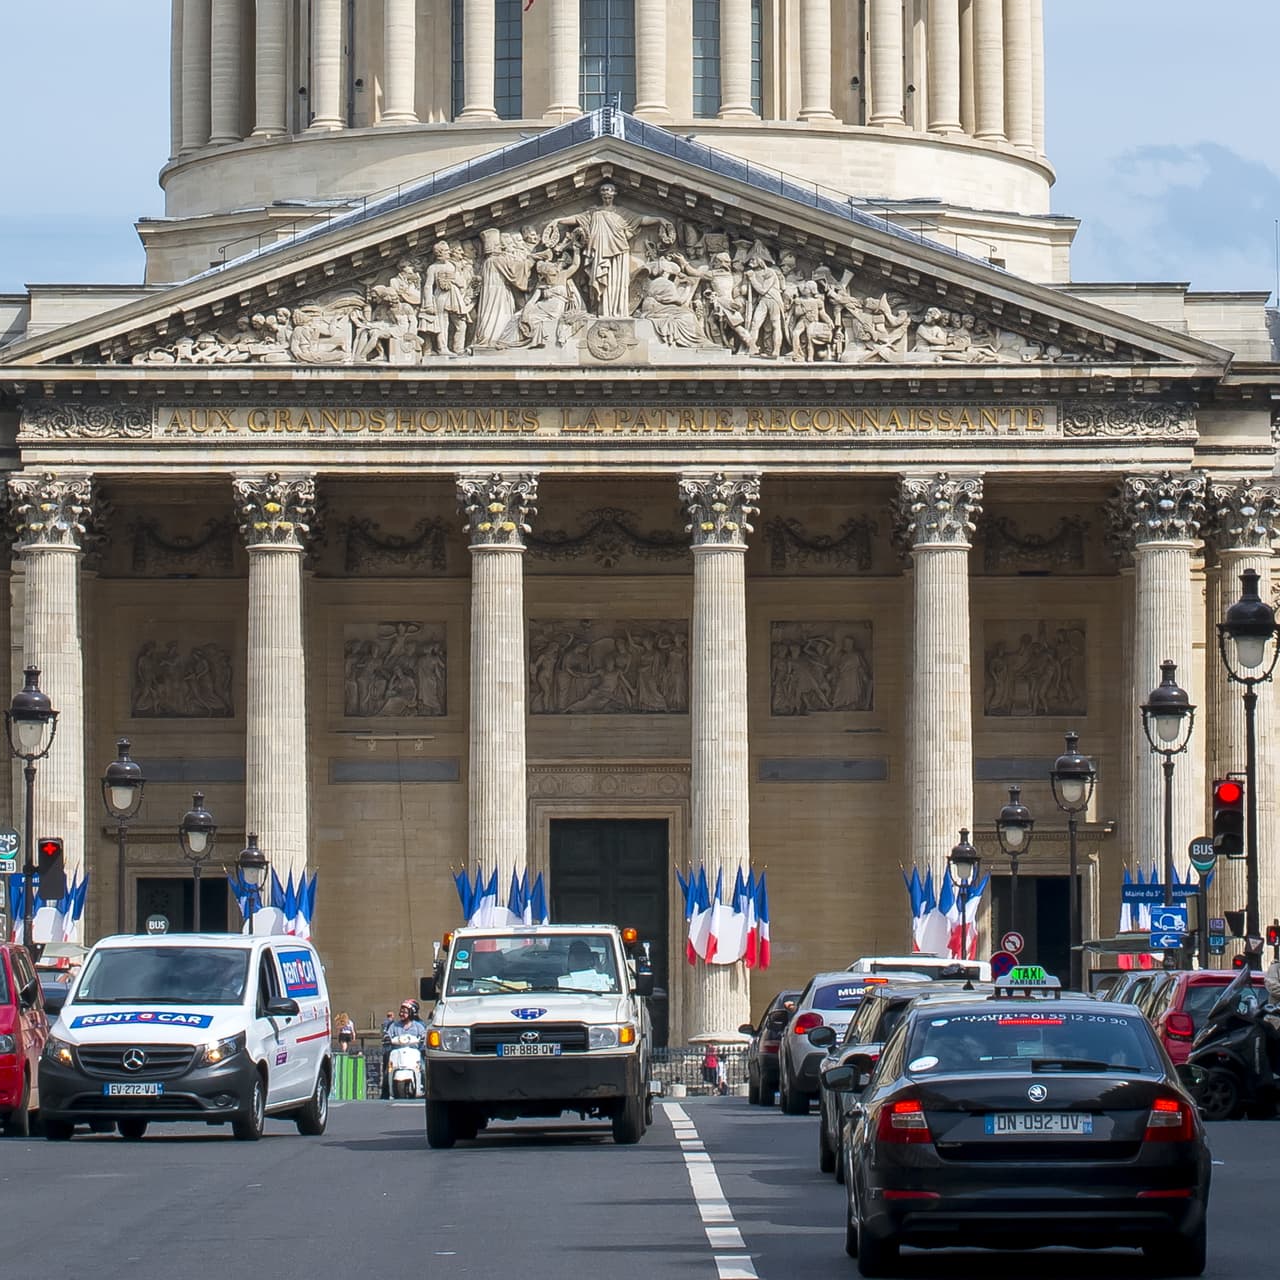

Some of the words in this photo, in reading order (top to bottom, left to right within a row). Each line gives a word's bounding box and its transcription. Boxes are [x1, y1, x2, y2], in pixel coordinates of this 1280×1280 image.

[164, 407, 238, 433] AUX
[247, 407, 387, 433] GRANDS
[394, 407, 540, 433] HOMMES
[560, 407, 604, 433] LA
[612, 407, 735, 433] PATRIE
[745, 407, 1045, 433] RECONNAISSANTE
[1192, 844, 1214, 856] BUS
[148, 920, 166, 930] BUS
[282, 961, 300, 984] RENT
[1015, 967, 1041, 979] TAXI
[81, 1013, 136, 1025] RENT
[158, 1013, 202, 1024] CAR
[1088, 1015, 1106, 1023] 20
[1109, 1017, 1128, 1026] 90
